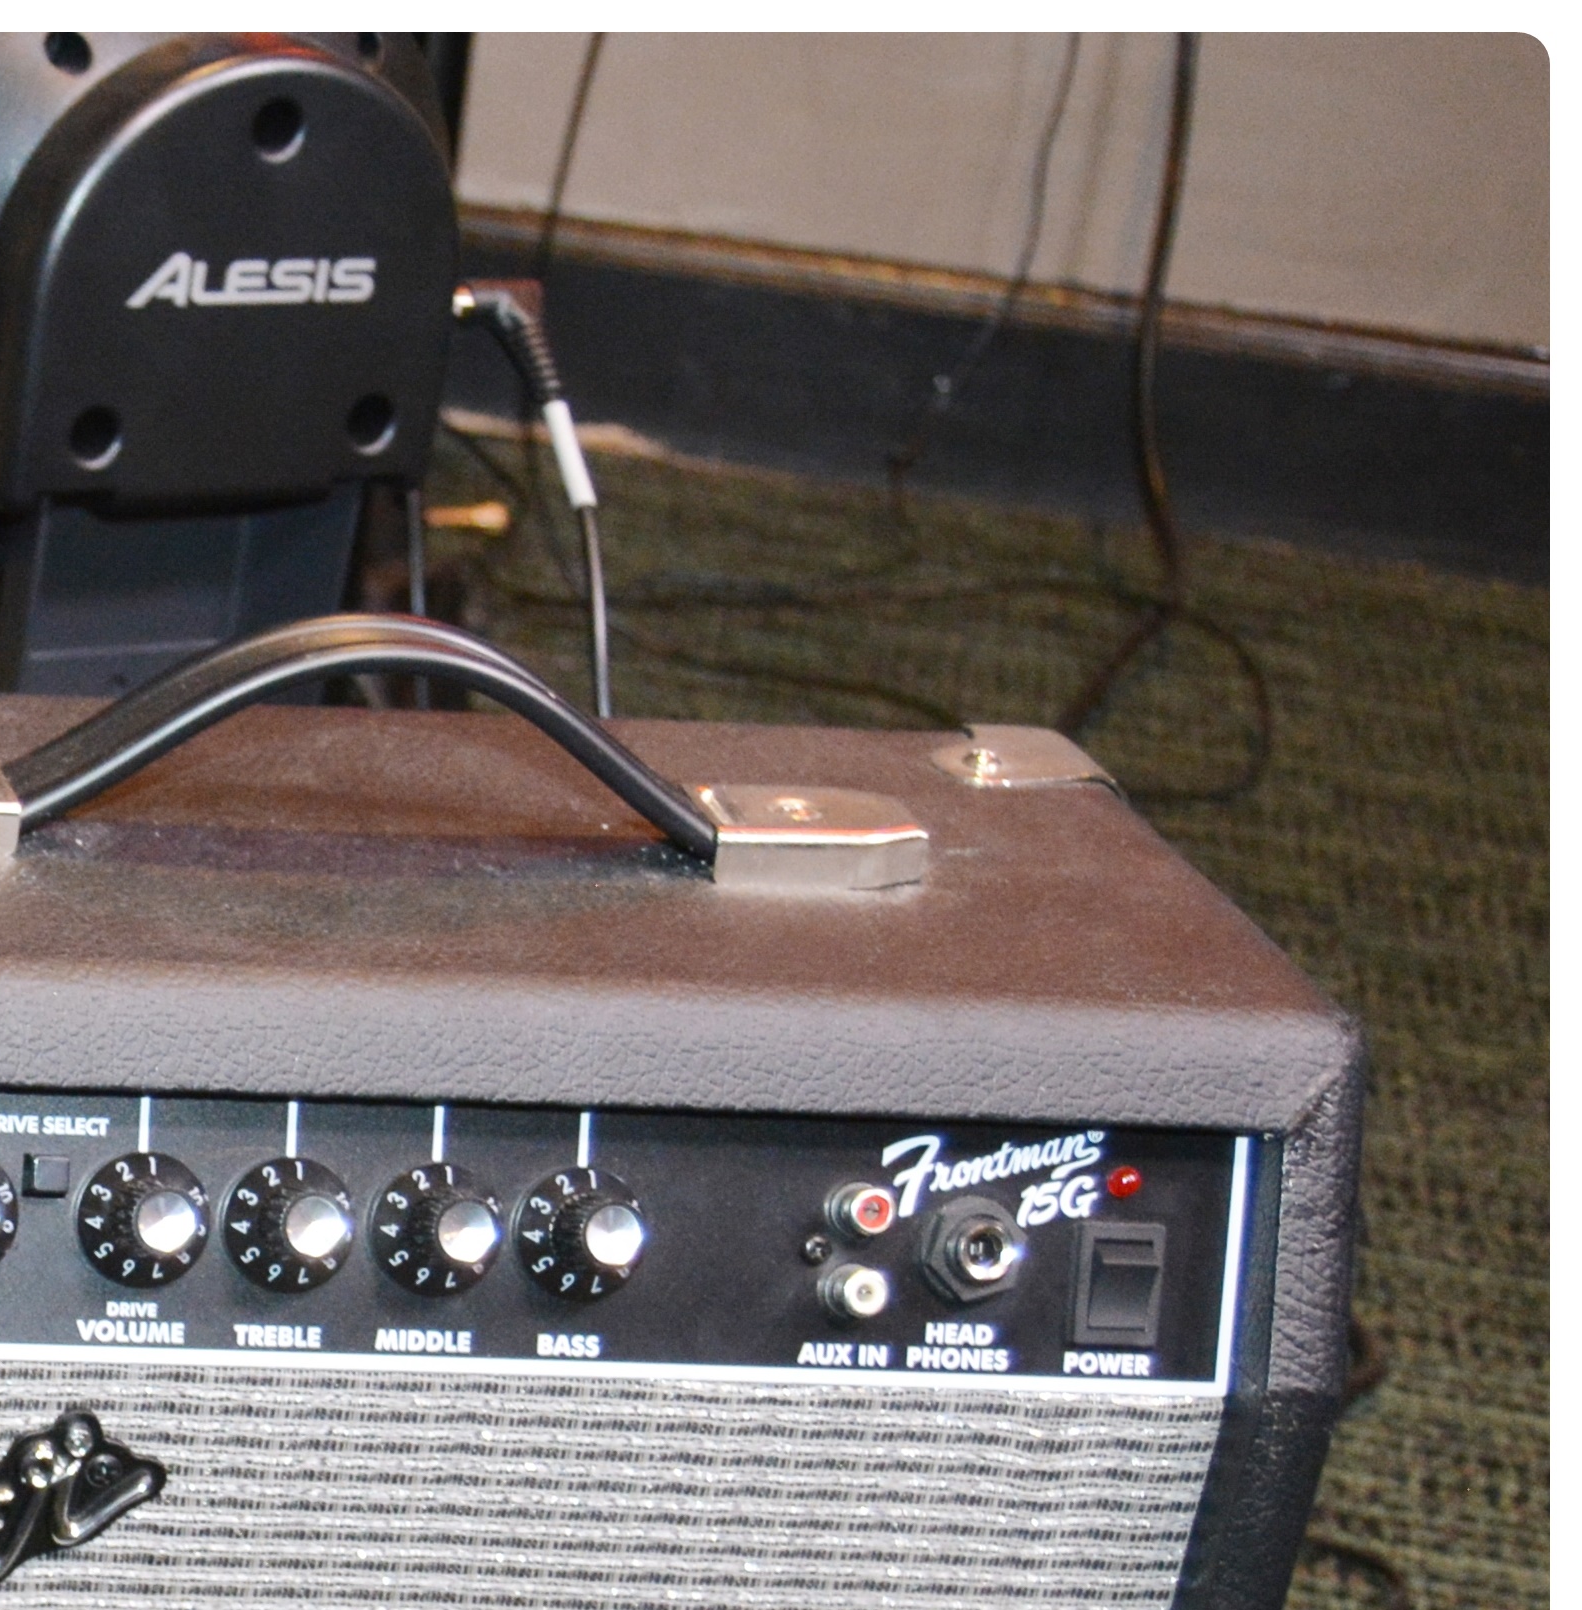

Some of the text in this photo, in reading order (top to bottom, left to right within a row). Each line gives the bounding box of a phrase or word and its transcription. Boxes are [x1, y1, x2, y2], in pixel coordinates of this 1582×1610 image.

[126, 252, 376, 309] ALESIS
[41, 1115, 109, 1137] SELECT
[115, 1161, 134, 1182] 2
[149, 1156, 156, 1176] 1
[91, 1184, 112, 1201] 3
[1015, 1175, 1099, 1228] 15G
[85, 1215, 104, 1230] 4
[231, 1161, 309, 1284] 1 2 3 4 5 6 7
[380, 1166, 456, 1288] 1 2 3 4 5 6 7
[522, 1170, 602, 1294] 1 2 3 4 5 6 7
[94, 1243, 114, 1259] 5
[122, 1259, 135, 1277] 6
[152, 1263, 163, 1278] 7
[105, 1301, 157, 1318] DRIVE
[77, 1319, 185, 1344] VOLUME
[234, 1323, 321, 1349] TREBLE
[375, 1328, 471, 1354] MIDDLE
[925, 1322, 994, 1345] HEAD
[537, 1332, 600, 1358] BASS
[798, 1343, 887, 1368] AUX IN
[906, 1347, 1009, 1372] PHONES
[1064, 1353, 1149, 1376] POWER
